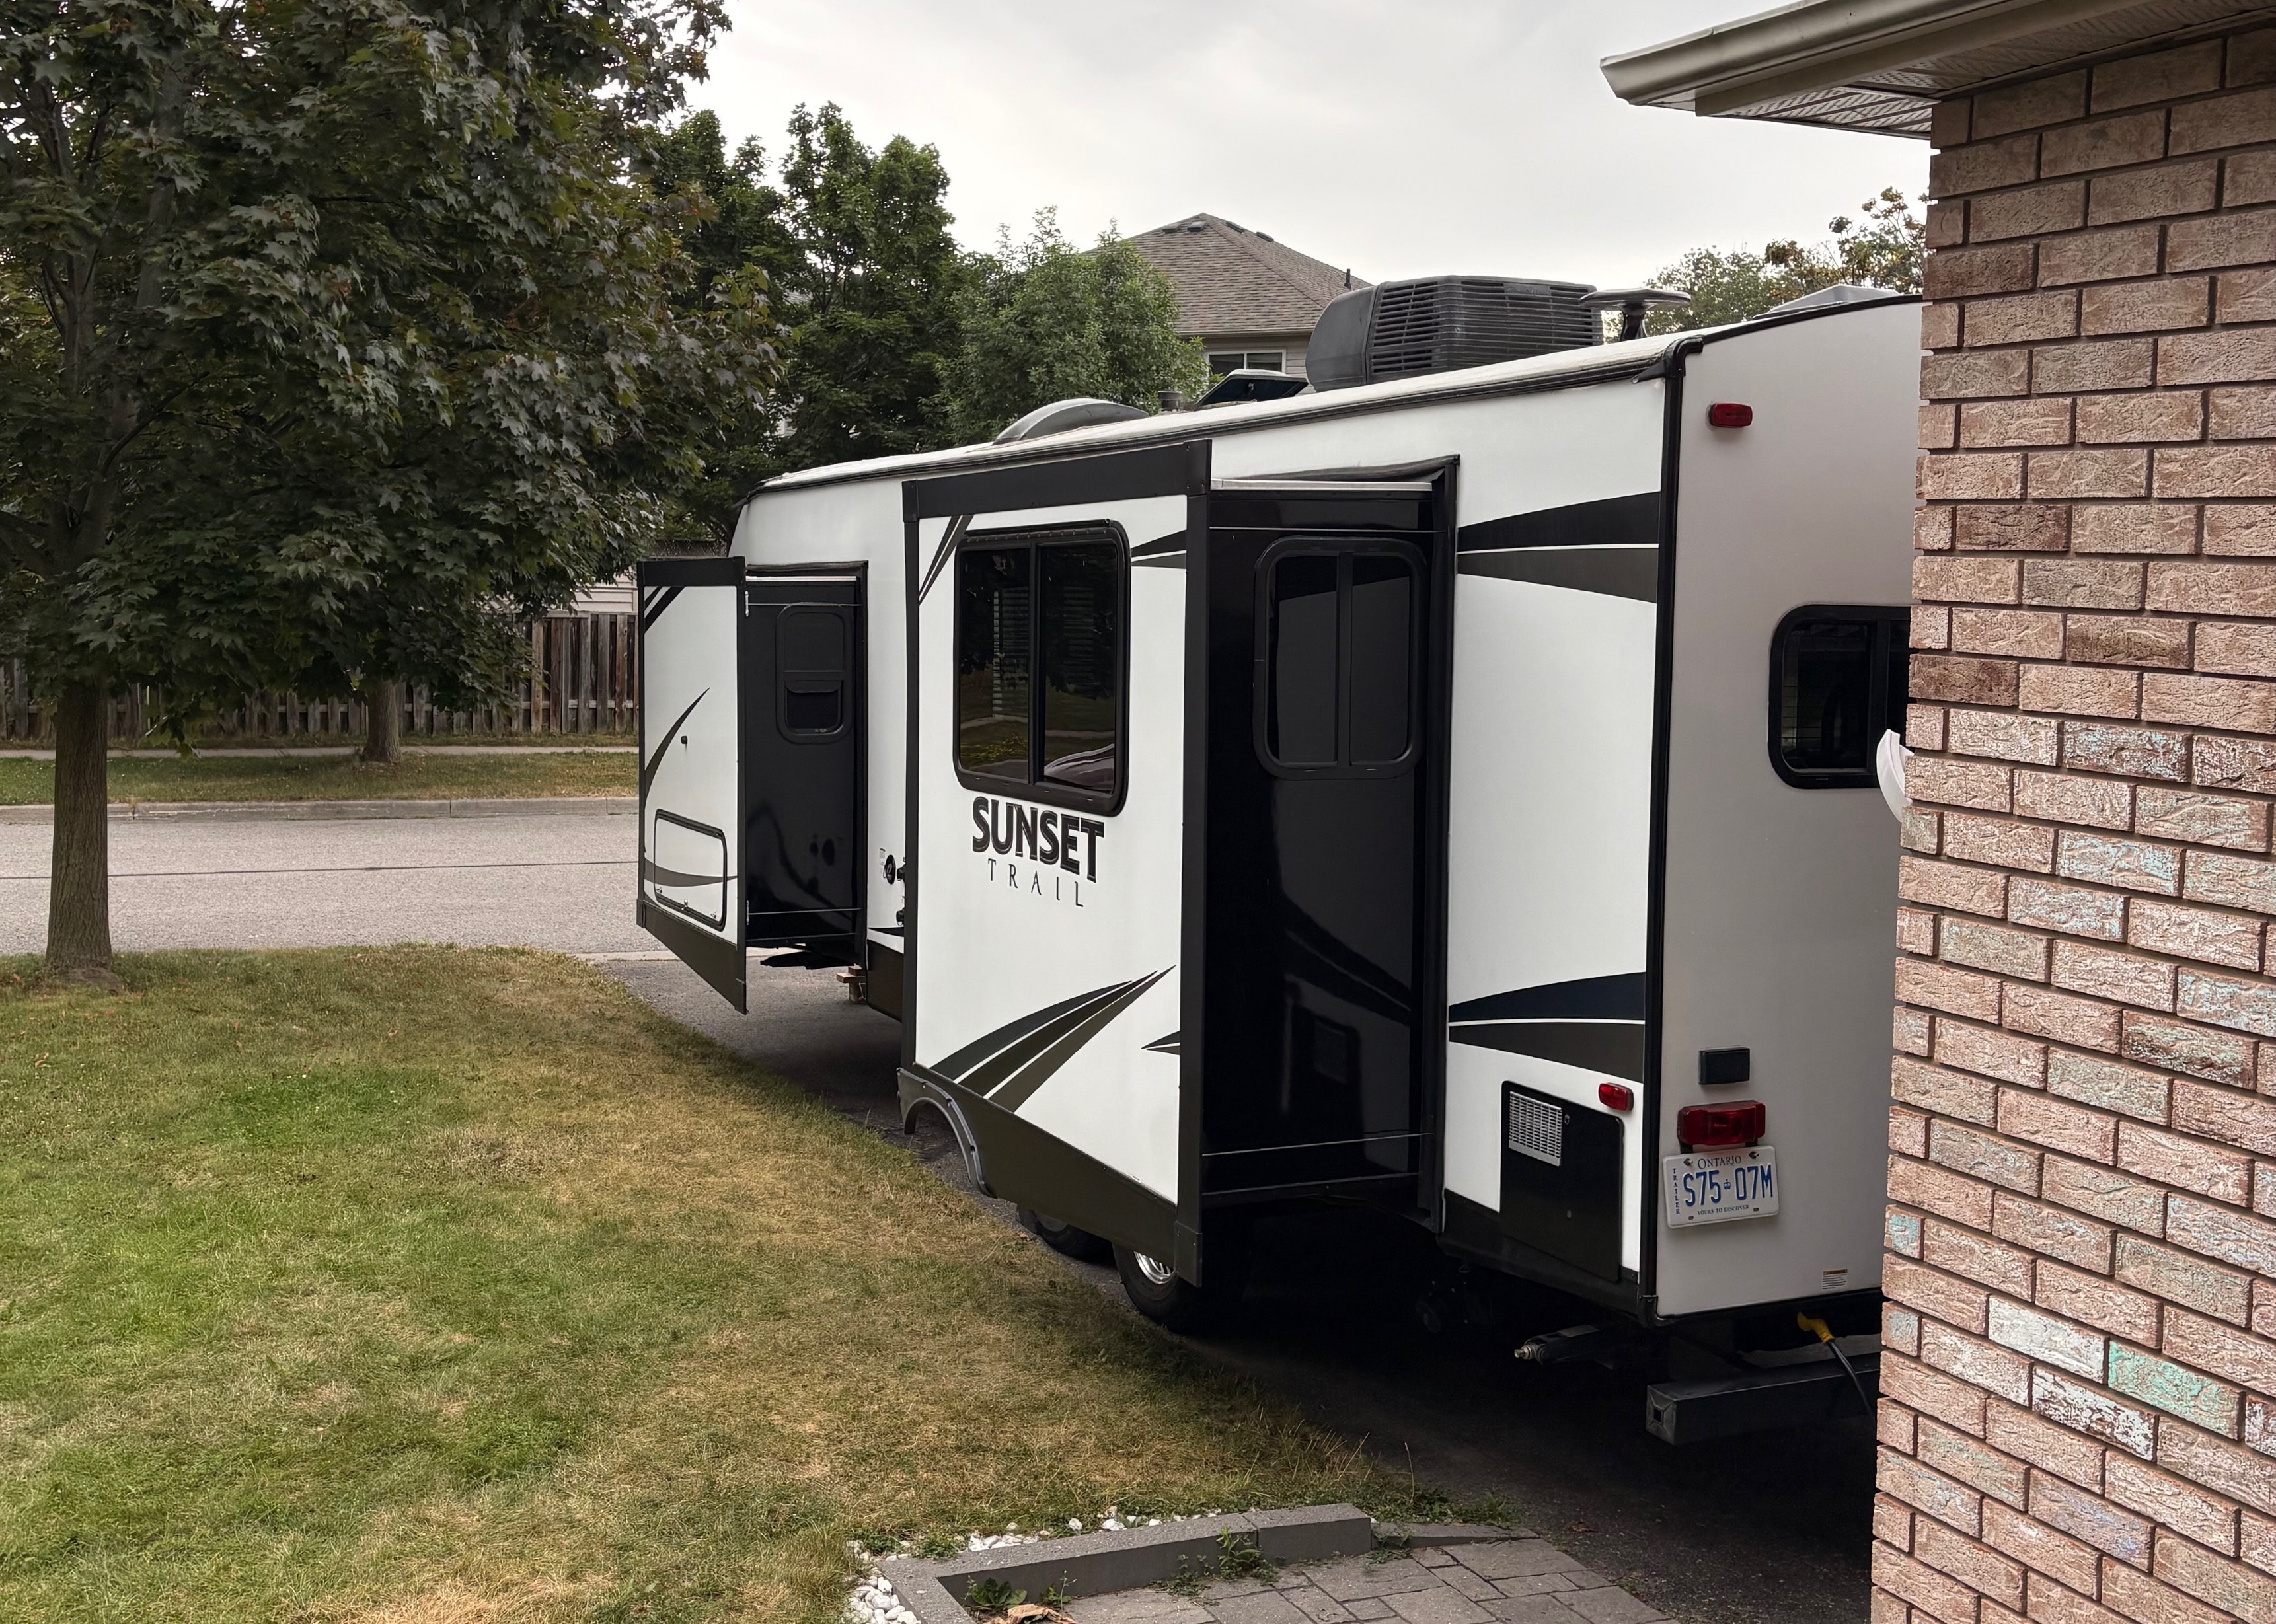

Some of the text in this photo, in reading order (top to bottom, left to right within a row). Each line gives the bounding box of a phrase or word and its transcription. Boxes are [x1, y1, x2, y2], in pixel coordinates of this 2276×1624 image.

[972, 796, 1105, 883] SUNSET
[988, 858, 1084, 908] TRAIL
[1698, 1156, 1742, 1169] ONTARIO
[1683, 1164, 1774, 1207] S75 07M
[1724, 1204, 1749, 1213] DISCOVER
